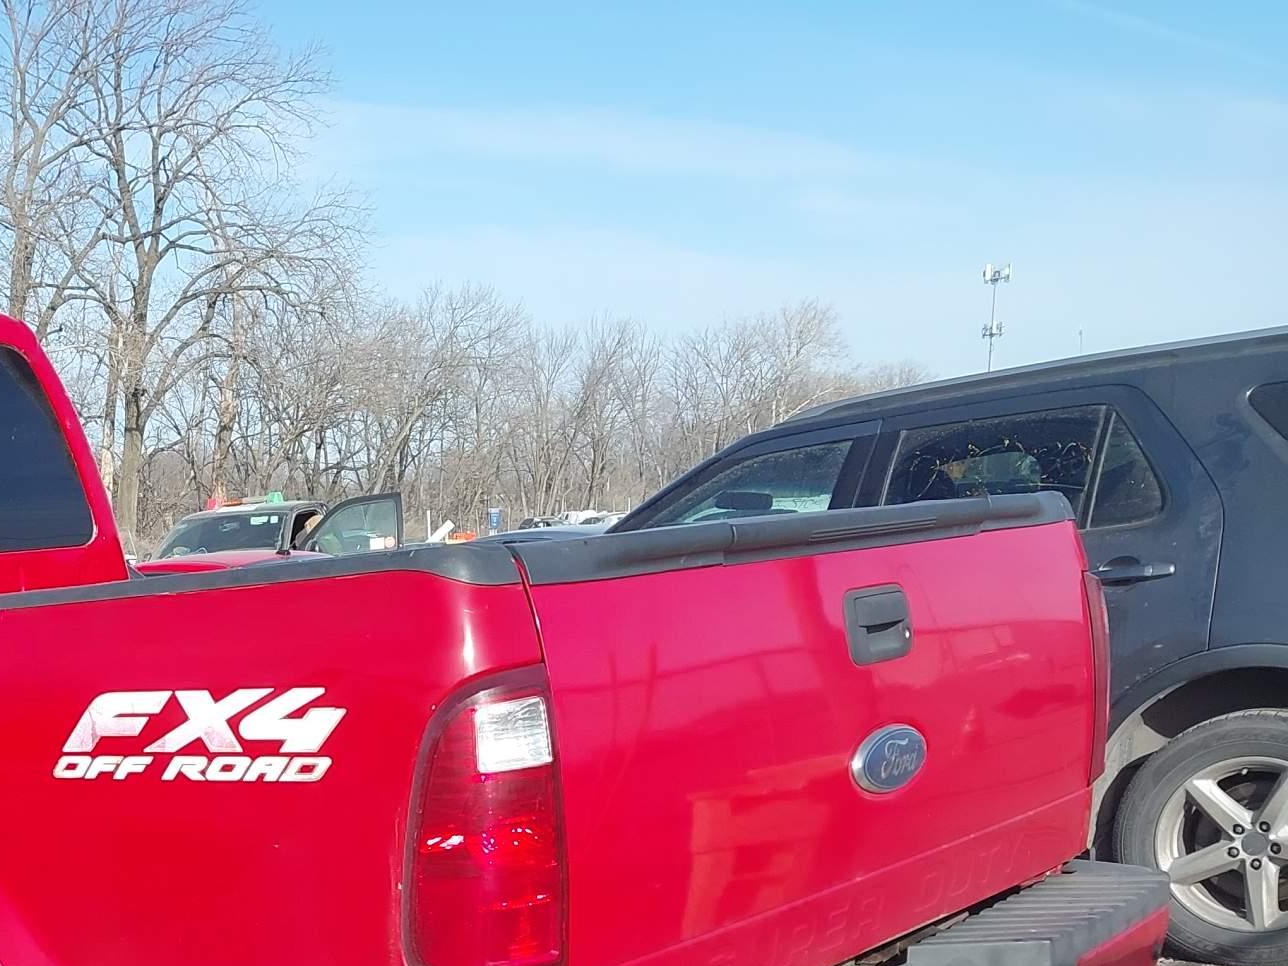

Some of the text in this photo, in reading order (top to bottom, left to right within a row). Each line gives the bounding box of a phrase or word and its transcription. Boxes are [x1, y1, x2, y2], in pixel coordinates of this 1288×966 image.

[62, 687, 347, 752] FX4
[52, 755, 332, 782] OFF ROAD
[880, 737, 919, 779] Ford
